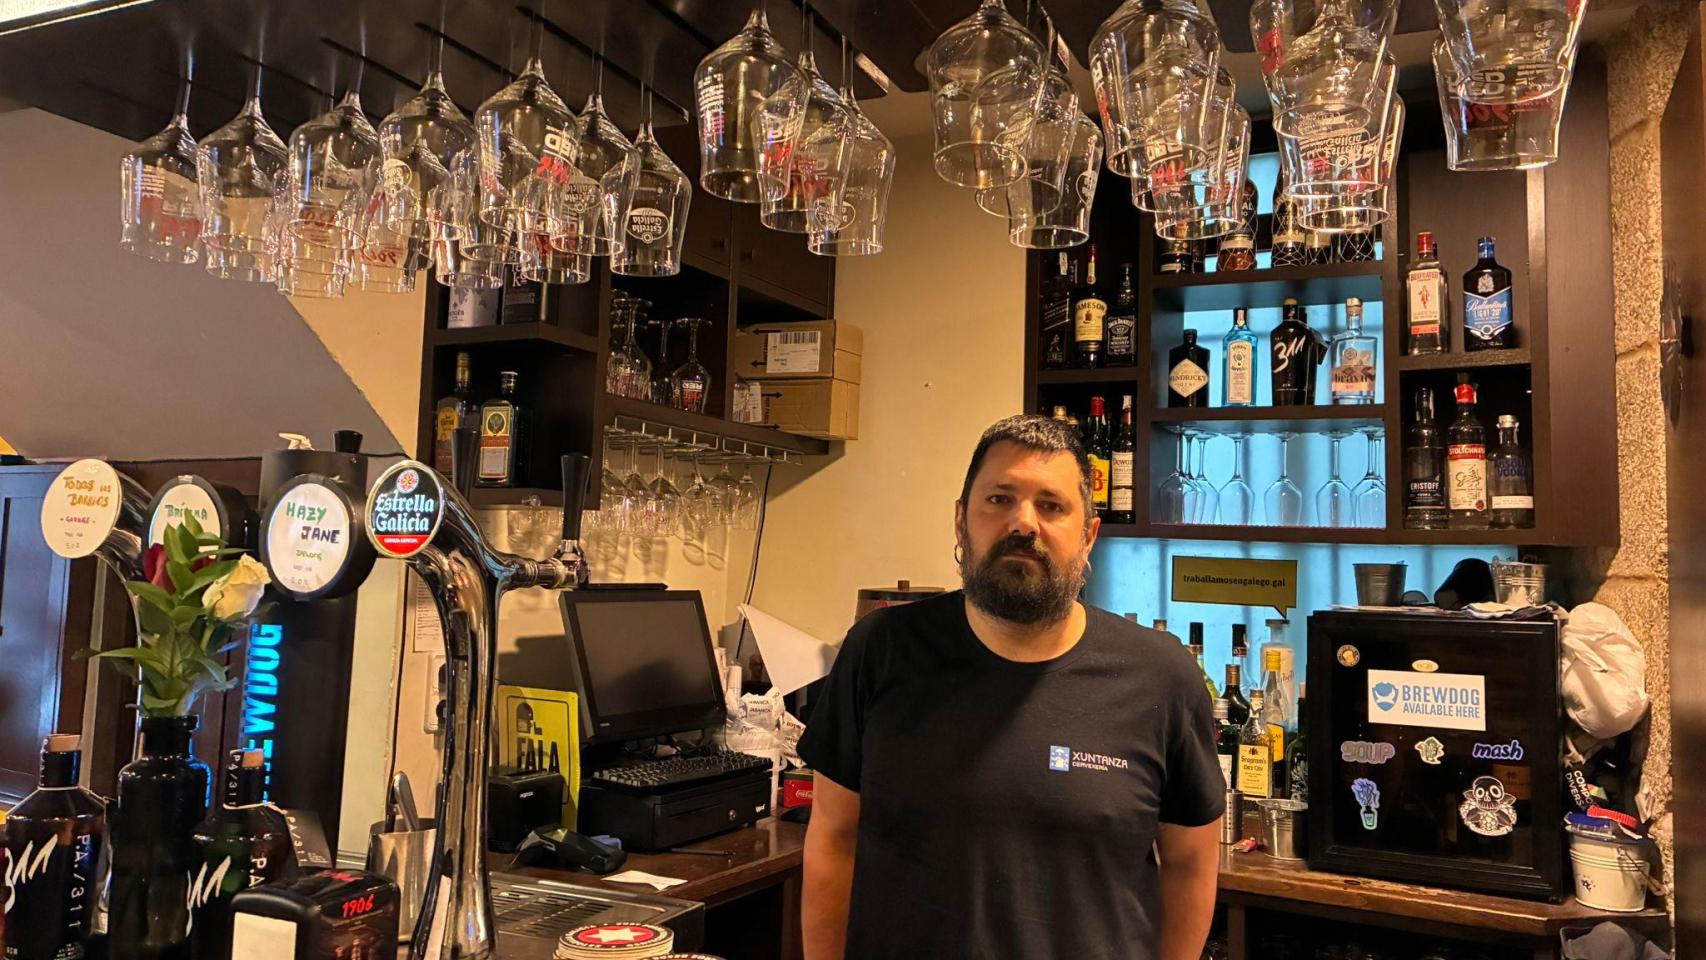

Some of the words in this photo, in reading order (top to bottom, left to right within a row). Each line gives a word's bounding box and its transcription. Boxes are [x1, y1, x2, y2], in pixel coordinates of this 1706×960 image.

[631, 224, 663, 234] Estrella
[632, 216, 663, 226] Galicia
[1410, 482, 1440, 490] ERISTOFF
[375, 490, 435, 513] Estrella
[286, 502, 328, 523] HAZY
[373, 512, 430, 533] Galicia
[301, 525, 341, 544] JANE
[1183, 574, 1286, 588] traballamosengalego.gal
[1402, 684, 1481, 706] BREWDOG
[1402, 702, 1454, 717] AVAILABLE
[1455, 706, 1481, 719] HERE
[516, 737, 560, 773] FALA
[1473, 741, 1522, 759] mash
[1072, 751, 1129, 769] XUNTANZA
[341, 893, 375, 918] 1906
